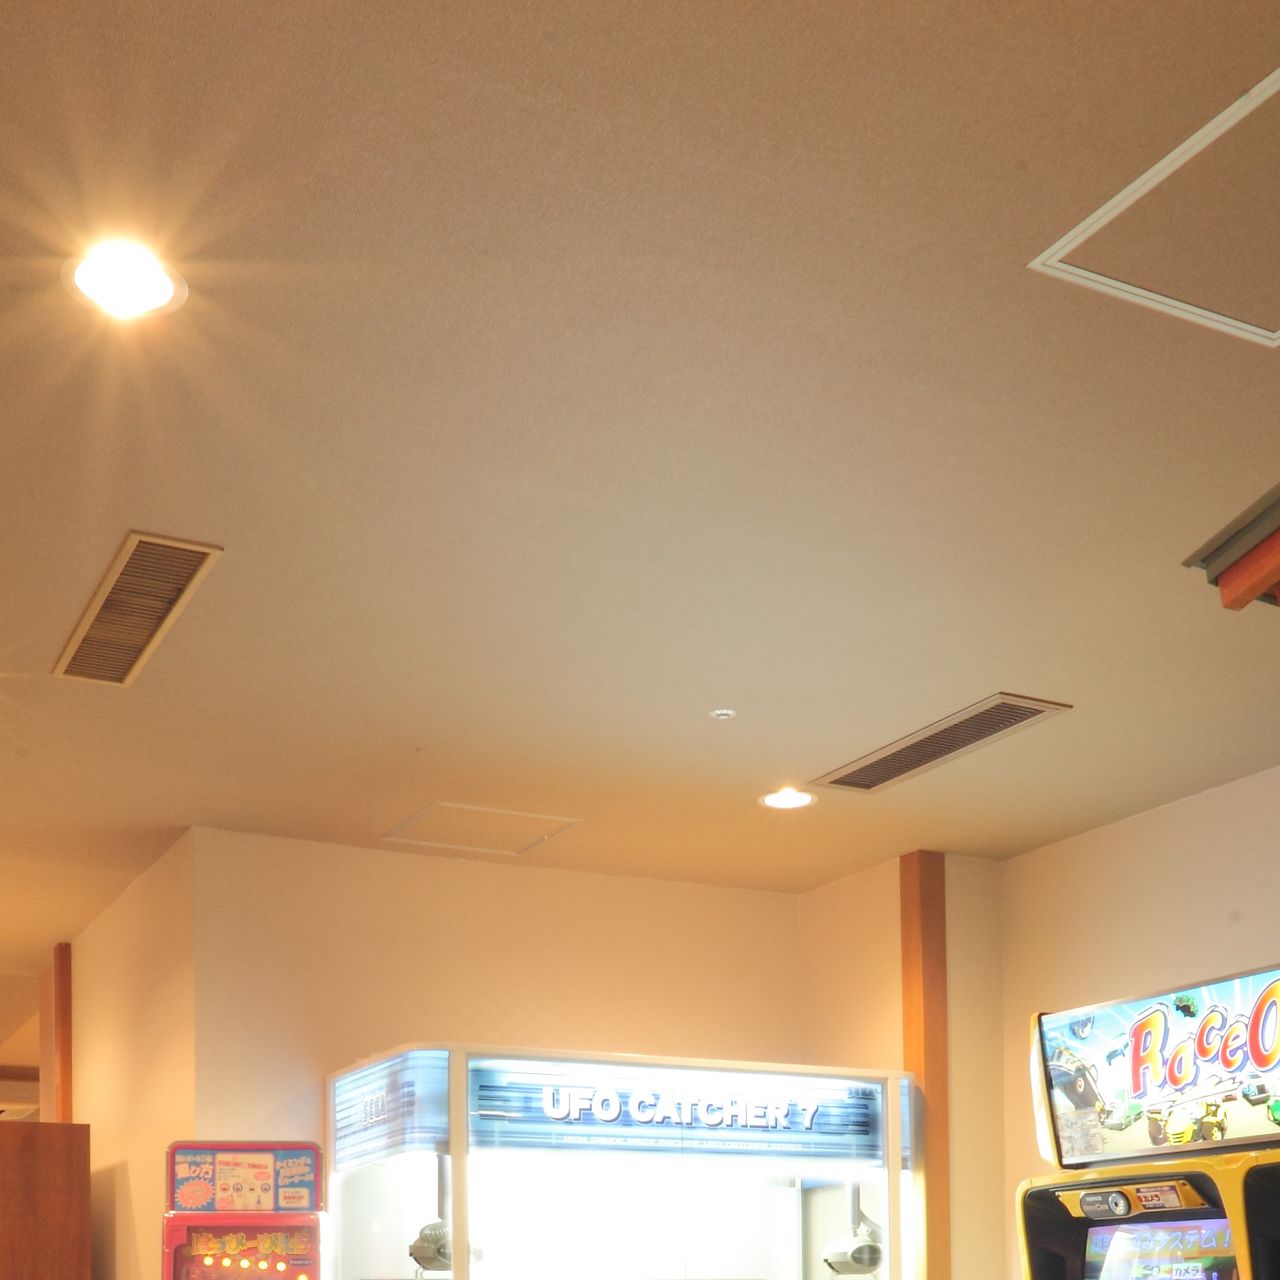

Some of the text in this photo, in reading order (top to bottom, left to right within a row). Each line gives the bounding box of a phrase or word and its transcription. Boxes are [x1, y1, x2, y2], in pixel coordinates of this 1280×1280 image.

[542, 1086, 820, 1131] UFO CATCHER 7
